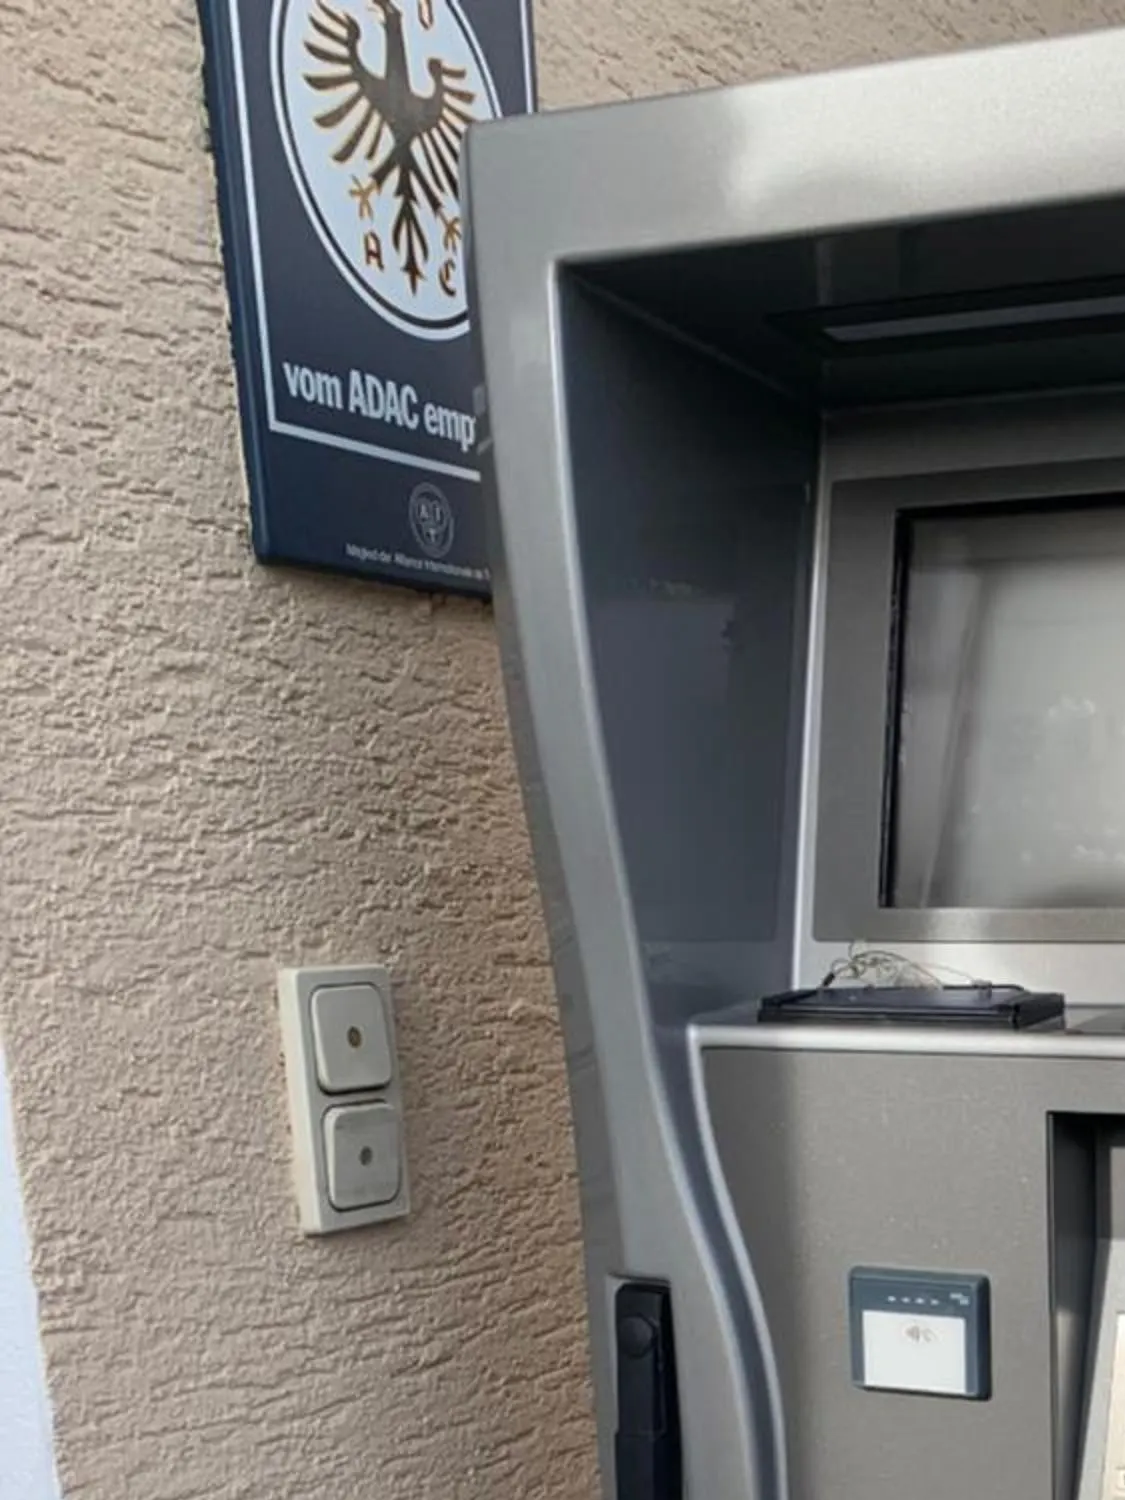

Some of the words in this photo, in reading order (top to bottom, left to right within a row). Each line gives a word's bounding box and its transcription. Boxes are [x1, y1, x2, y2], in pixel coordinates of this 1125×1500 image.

[283, 361, 343, 410] vom
[349, 368, 420, 430] ADAC
[424, 402, 476, 453] emp
